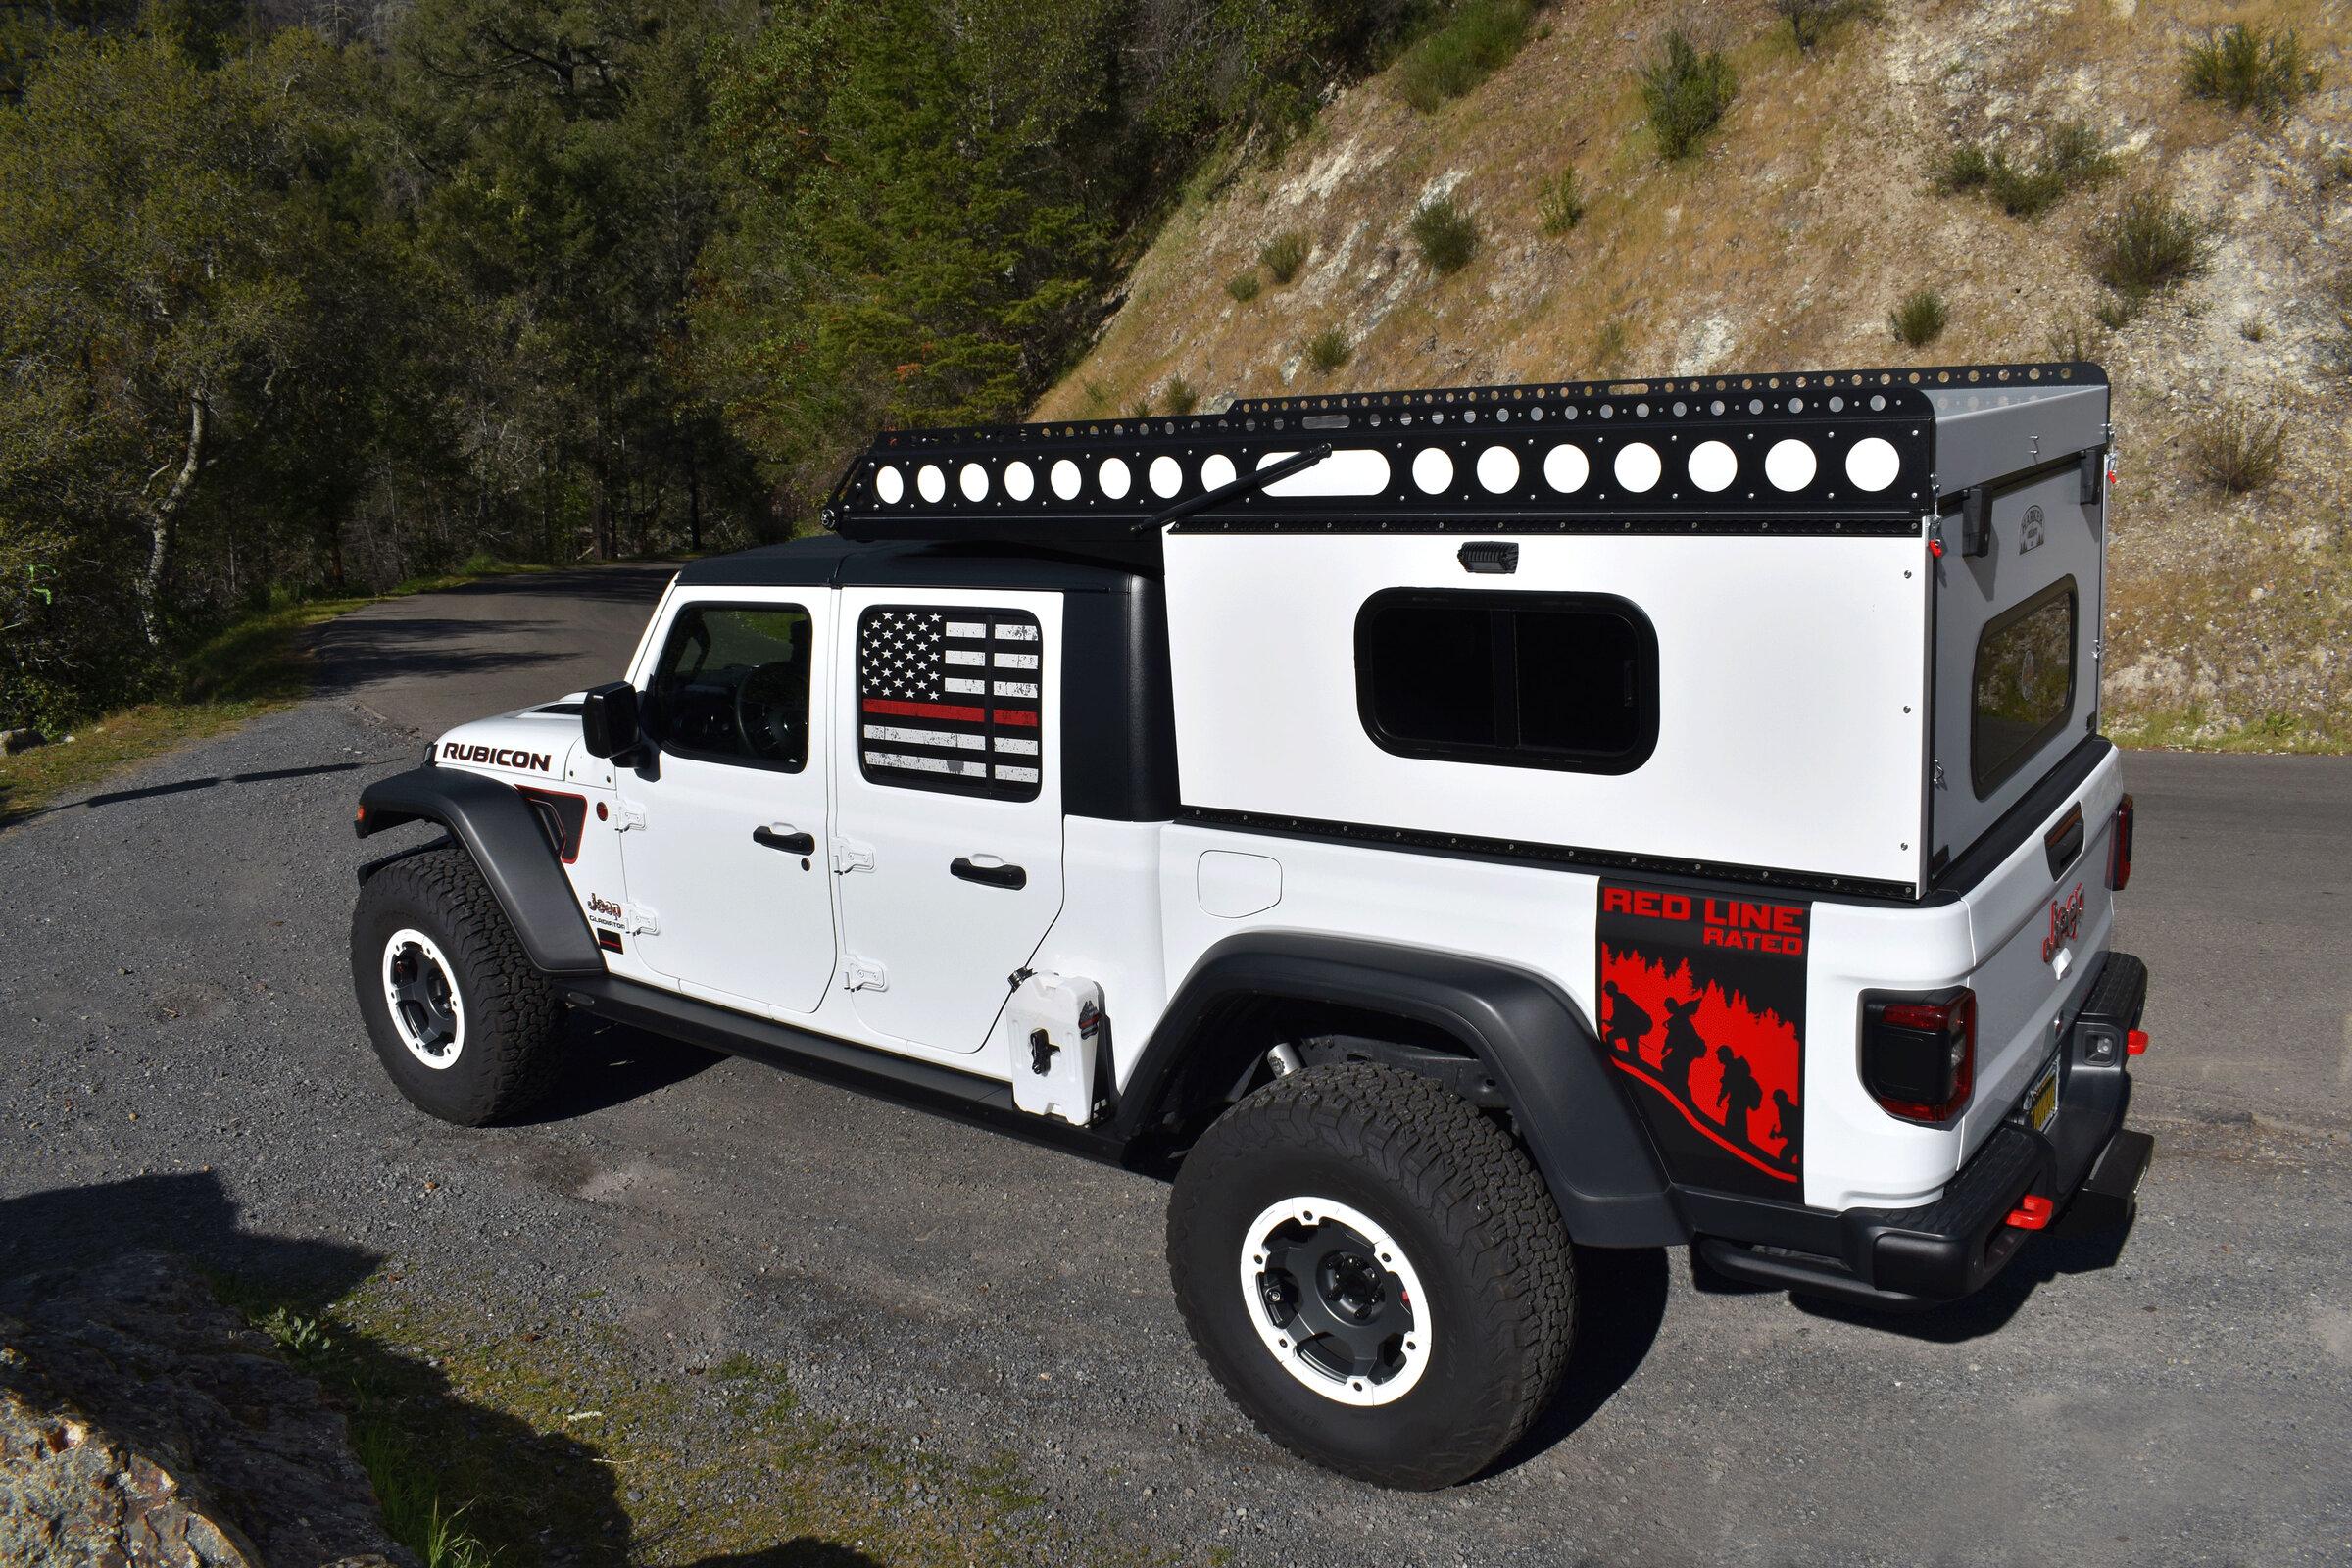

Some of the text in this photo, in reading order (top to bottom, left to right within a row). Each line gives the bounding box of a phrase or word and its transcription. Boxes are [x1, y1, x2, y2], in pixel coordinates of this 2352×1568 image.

[443, 742, 551, 772] RUBICON
[587, 892, 622, 921] Jeep
[1603, 887, 1805, 934] RED LINE
[589, 915, 626, 930] GLADIATOR
[2041, 882, 2084, 963] Jeep
[1703, 927, 1803, 956] RATED
